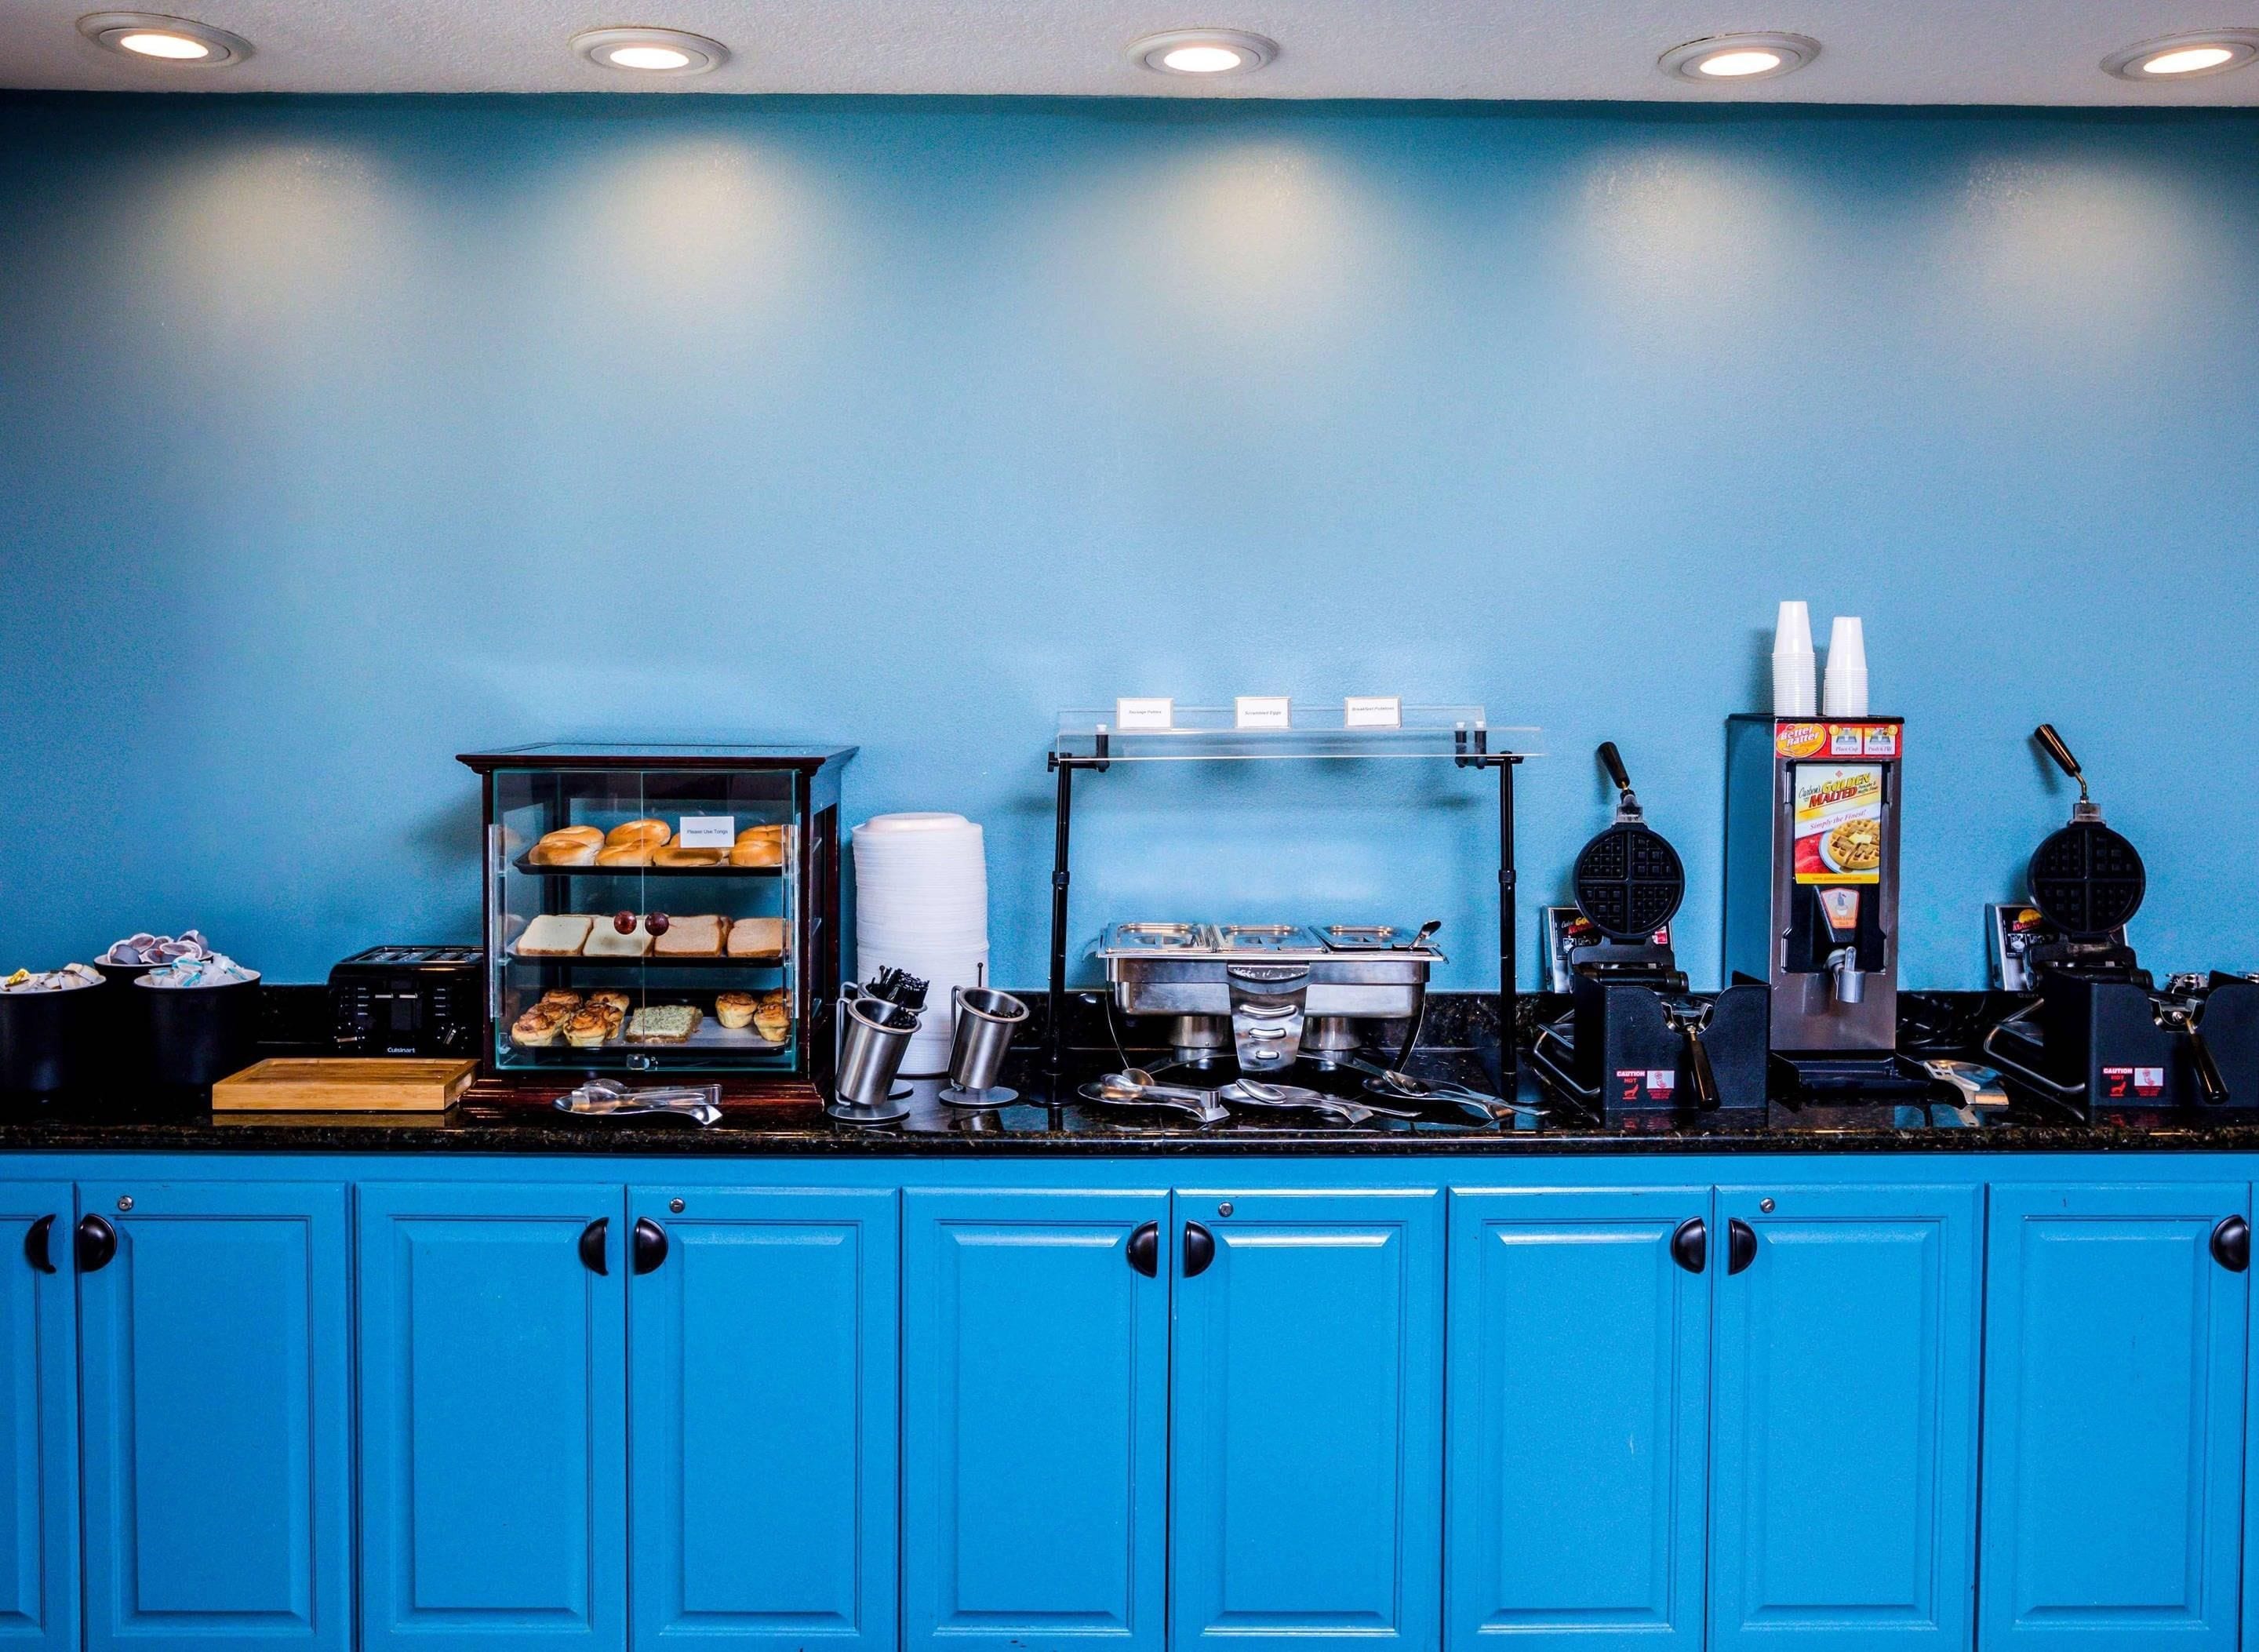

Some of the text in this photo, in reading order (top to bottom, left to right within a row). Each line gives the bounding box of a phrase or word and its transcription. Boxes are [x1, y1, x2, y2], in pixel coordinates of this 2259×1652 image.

[1781, 726, 1813, 740] Better
[1821, 772, 1871, 794] GOLDEN
[1809, 786, 1858, 808] MALTED
[1810, 819, 1831, 829] Simply
